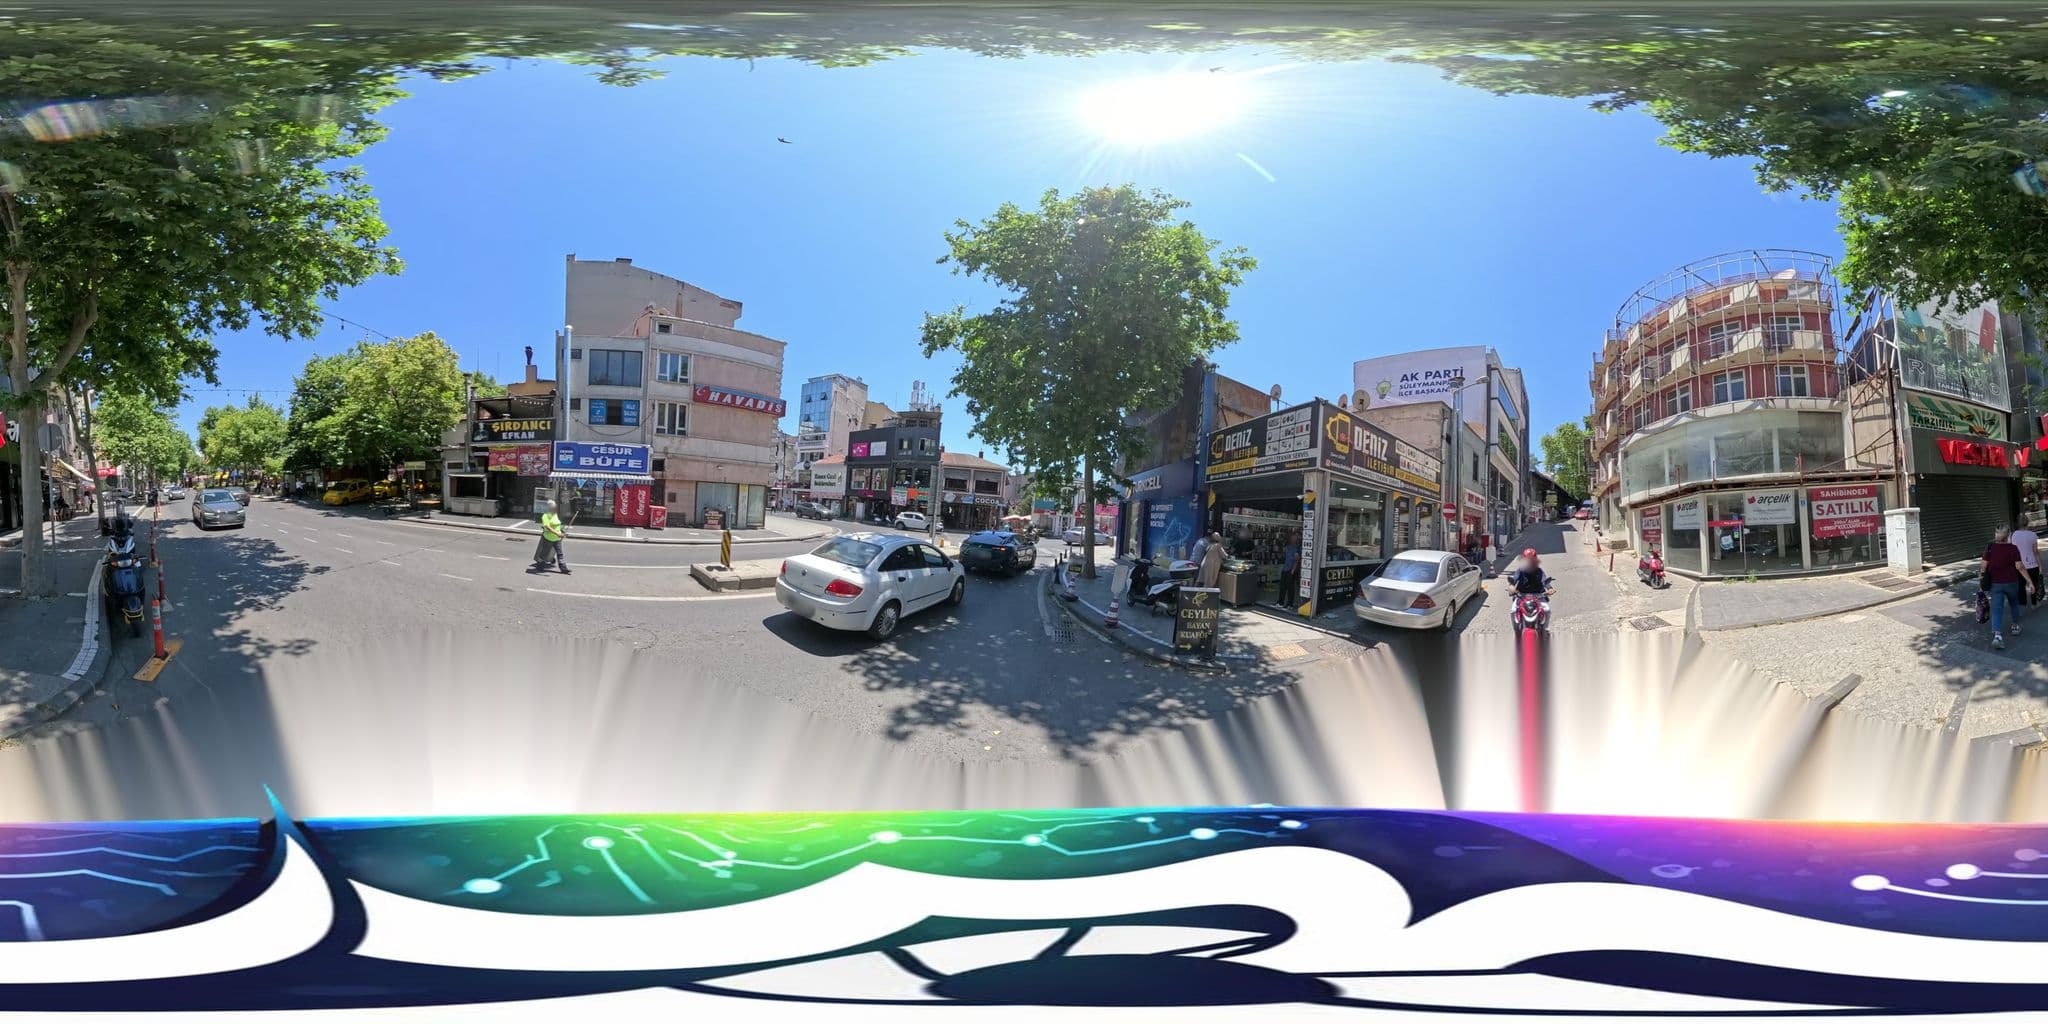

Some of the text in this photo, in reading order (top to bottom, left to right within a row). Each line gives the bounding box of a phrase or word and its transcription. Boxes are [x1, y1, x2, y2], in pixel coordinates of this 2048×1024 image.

[1400, 366, 1463, 382] AK PARTİ
[1400, 380, 1451, 390] SÜLEYMANP
[502, 432, 536, 440] EFKAN
[1225, 428, 1252, 452] DENİZ
[1354, 426, 1388, 462] DENİZ
[592, 446, 632, 456] CESUR
[580, 456, 642, 468] BÜFE
[1757, 493, 1791, 506] arçelik
[1816, 501, 1874, 516] SATILIK
[1180, 608, 1217, 619] CEYLİN
